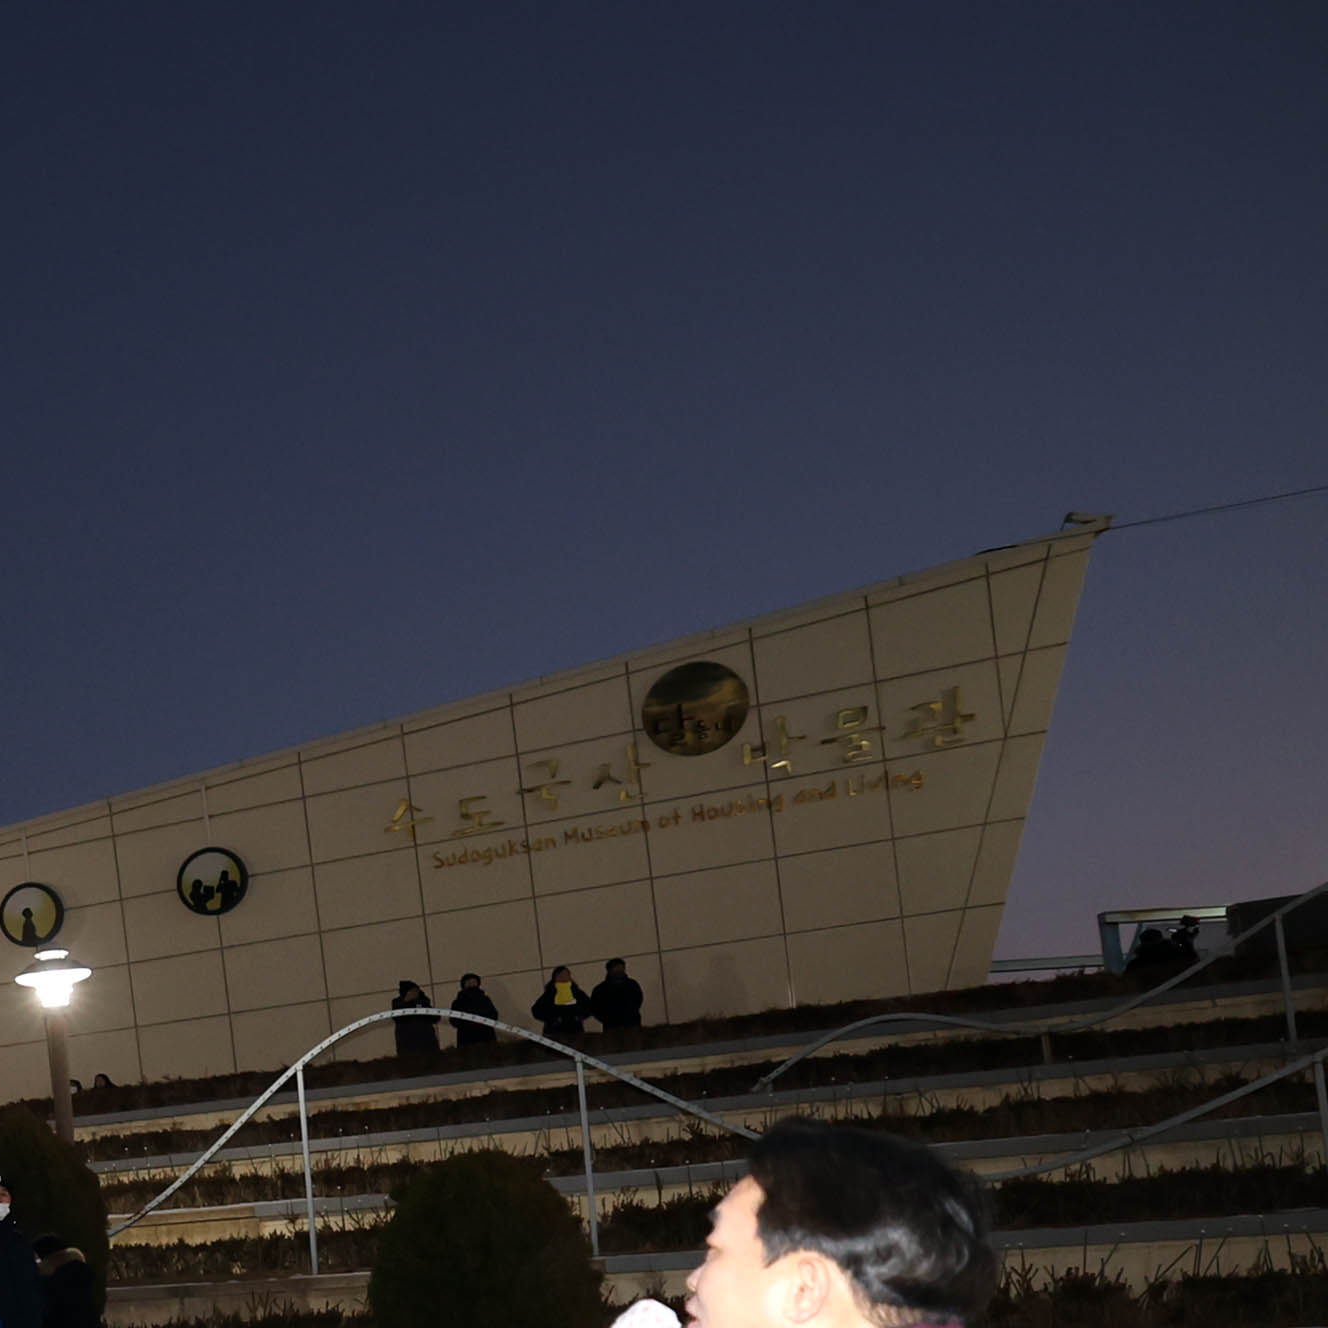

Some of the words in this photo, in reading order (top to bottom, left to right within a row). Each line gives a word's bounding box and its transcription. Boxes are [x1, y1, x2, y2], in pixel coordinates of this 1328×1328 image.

[383, 744, 651, 842] 수도국산
[743, 686, 976, 774] 박물관
[432, 837, 556, 869] Sudoguksan
[563, 817, 651, 846] Museum
[659, 809, 682, 829] of
[691, 795, 784, 823] Housing
[793, 780, 837, 804] and
[847, 769, 927, 796] Living
